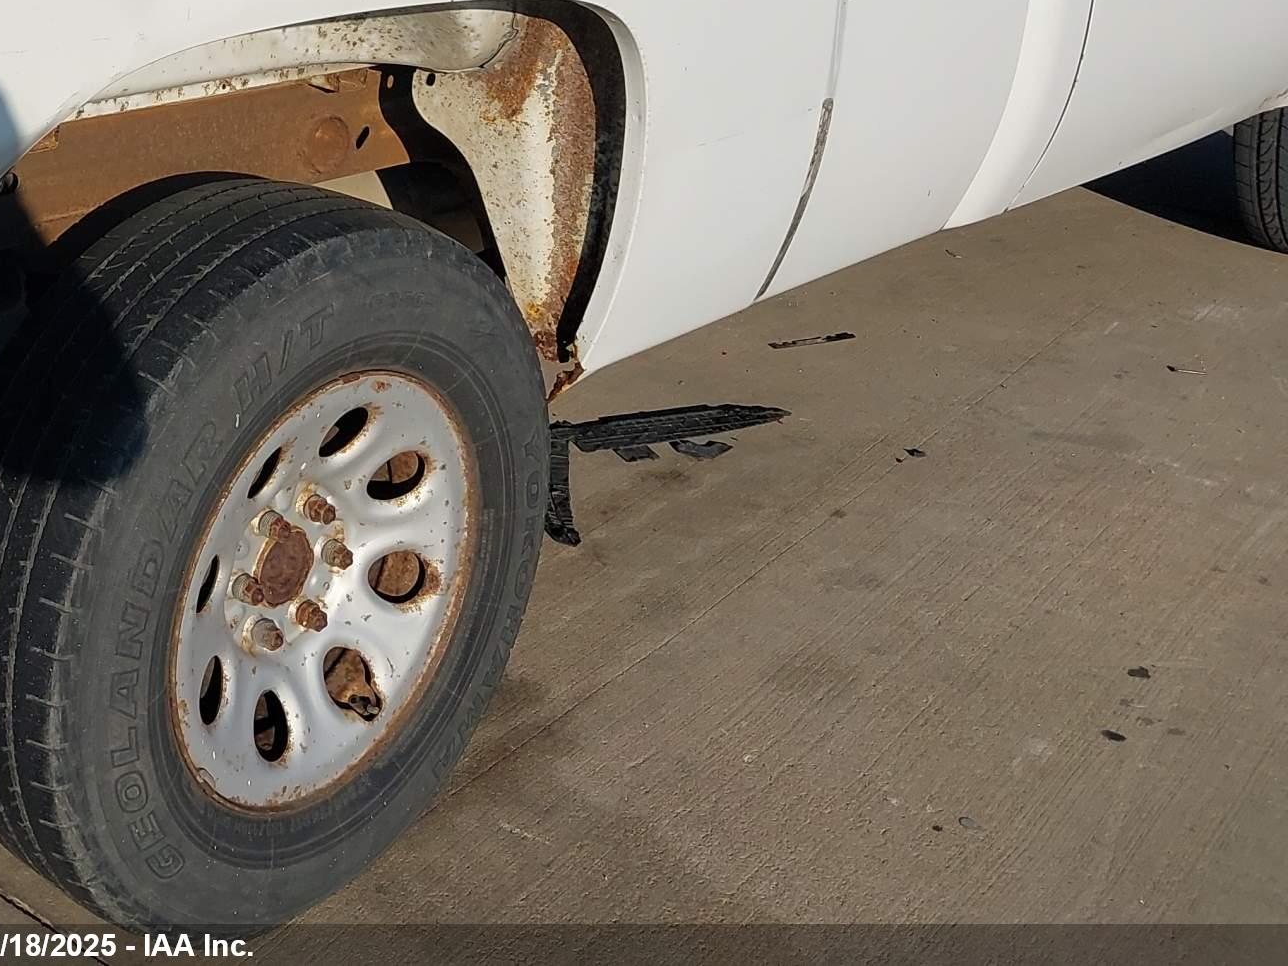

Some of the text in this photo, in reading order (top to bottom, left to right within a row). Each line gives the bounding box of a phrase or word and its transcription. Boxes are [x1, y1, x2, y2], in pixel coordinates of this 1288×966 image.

[110, 303, 335, 880] GEOLANDAR H/T
[433, 426, 544, 782] YOKOHAMA
